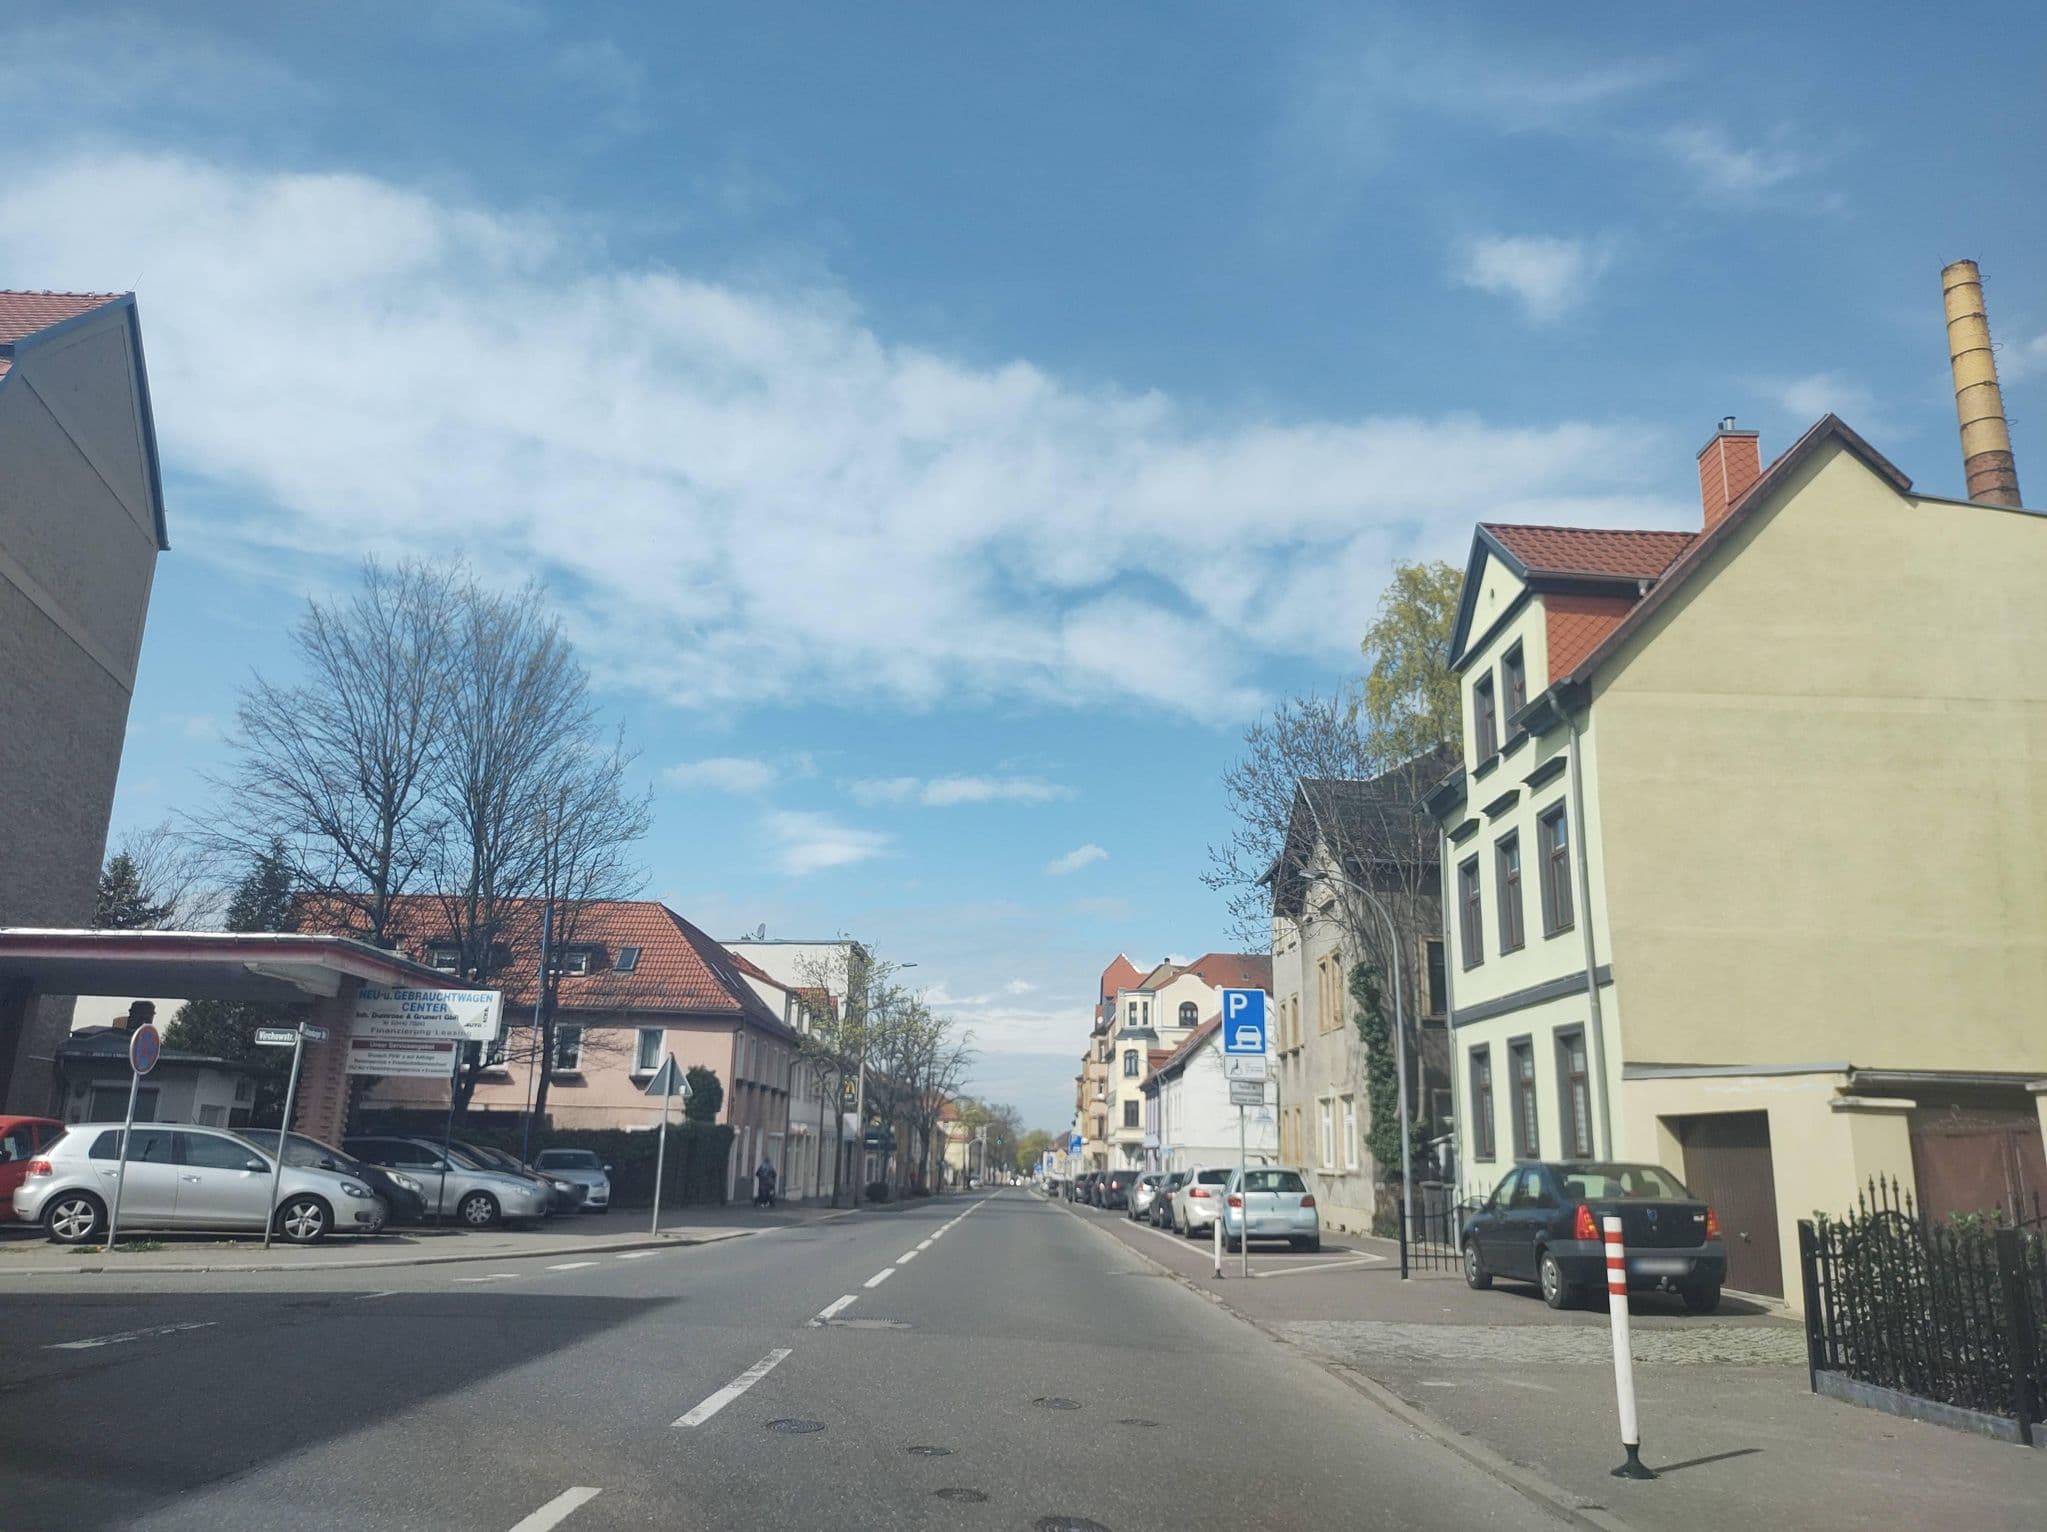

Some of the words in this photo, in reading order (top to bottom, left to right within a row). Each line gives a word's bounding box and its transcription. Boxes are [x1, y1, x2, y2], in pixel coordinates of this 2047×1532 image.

[395, 991, 494, 1003] GEBRAUCHTWAGEN
[402, 1002, 448, 1013] CENTER
[1229, 993, 1248, 1019] P
[370, 1027, 432, 1036] Finanzierung
